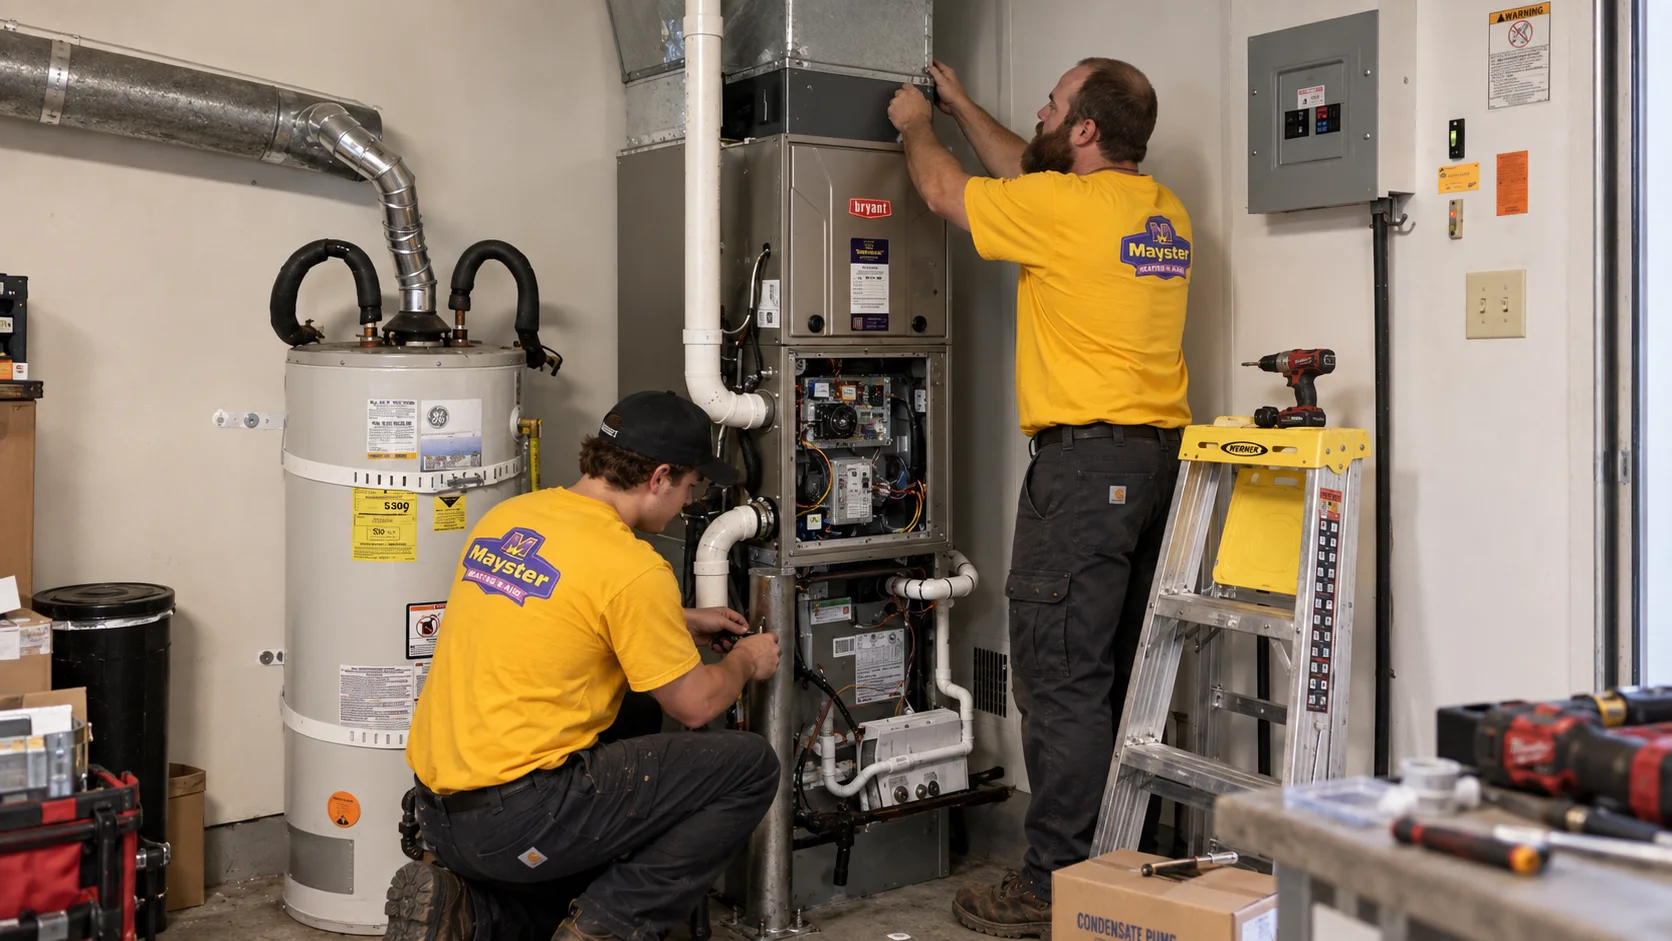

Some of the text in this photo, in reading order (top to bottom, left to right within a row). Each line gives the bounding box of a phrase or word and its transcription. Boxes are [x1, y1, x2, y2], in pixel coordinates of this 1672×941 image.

[1505, 6, 1544, 21] WARNING
[854, 200, 888, 215] bryant
[1128, 242, 1189, 262] Mayster
[1229, 444, 1259, 453] WERNER
[468, 544, 550, 587] Mayster
[1077, 912, 1143, 941] CONDENSATE
